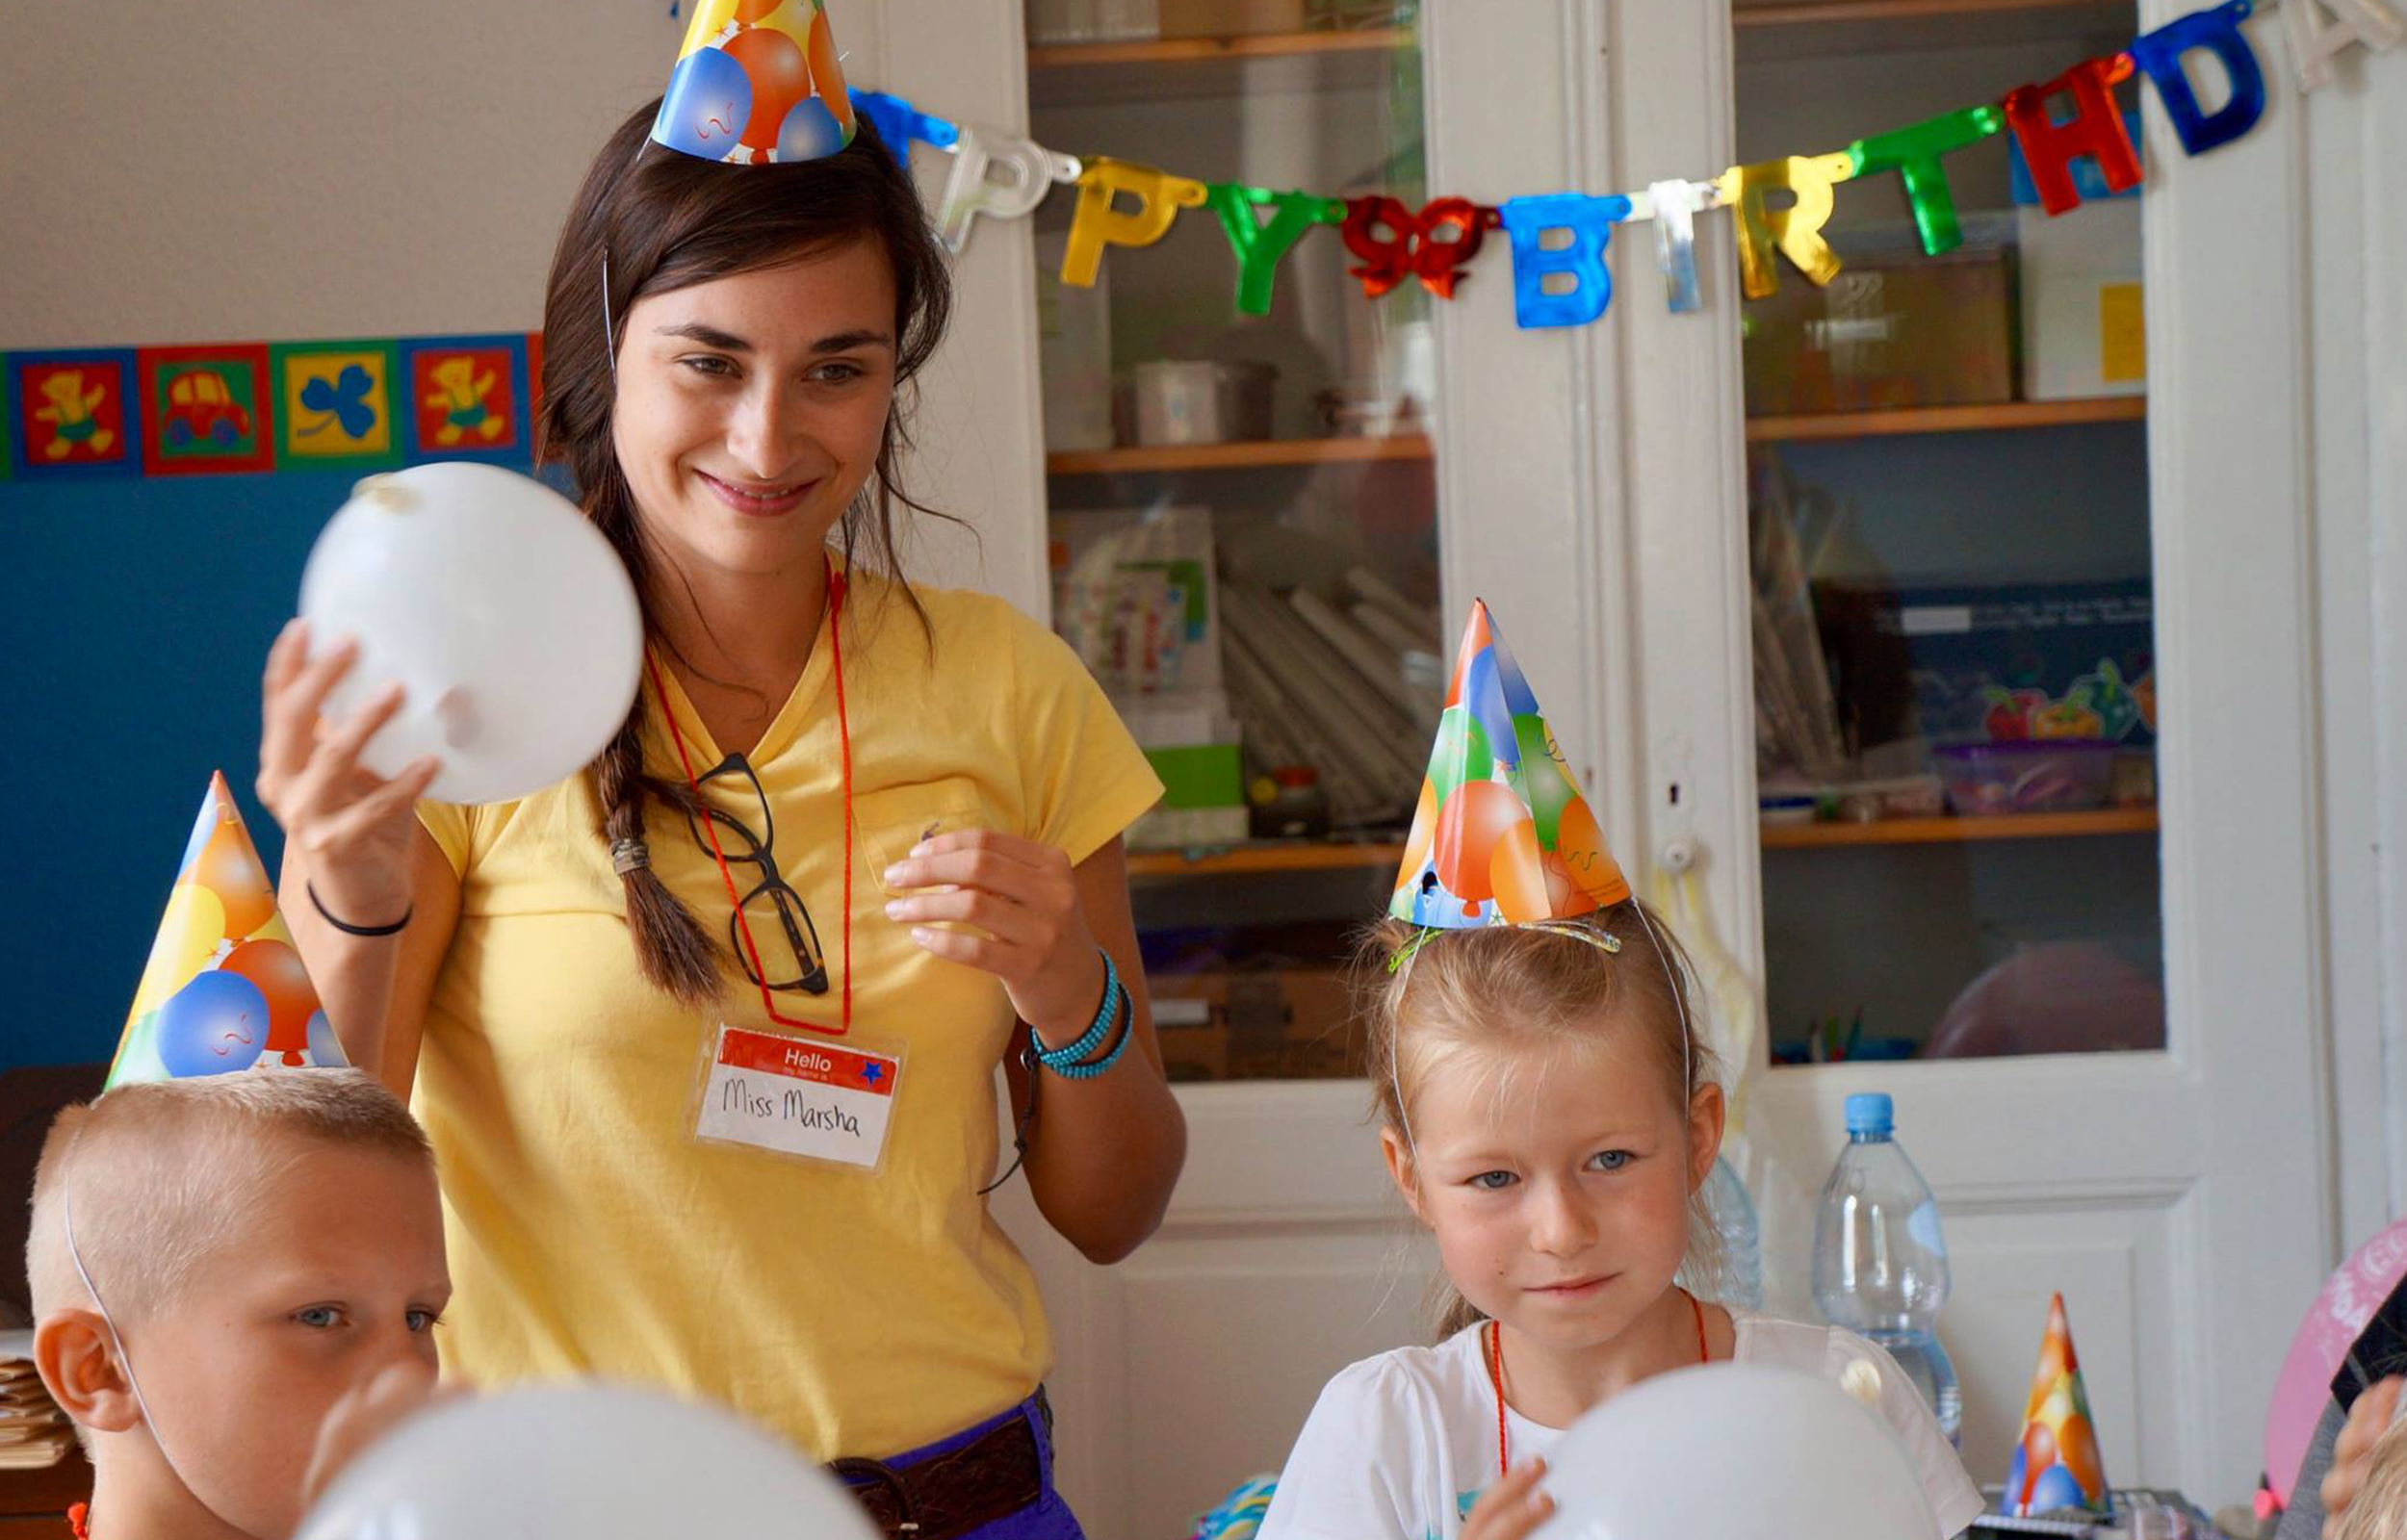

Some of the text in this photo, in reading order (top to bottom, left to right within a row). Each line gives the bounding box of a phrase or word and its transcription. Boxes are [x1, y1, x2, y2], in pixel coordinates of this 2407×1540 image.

[785, 1047, 832, 1072] Hello
[723, 1078, 860, 1137] Miss Marsha
